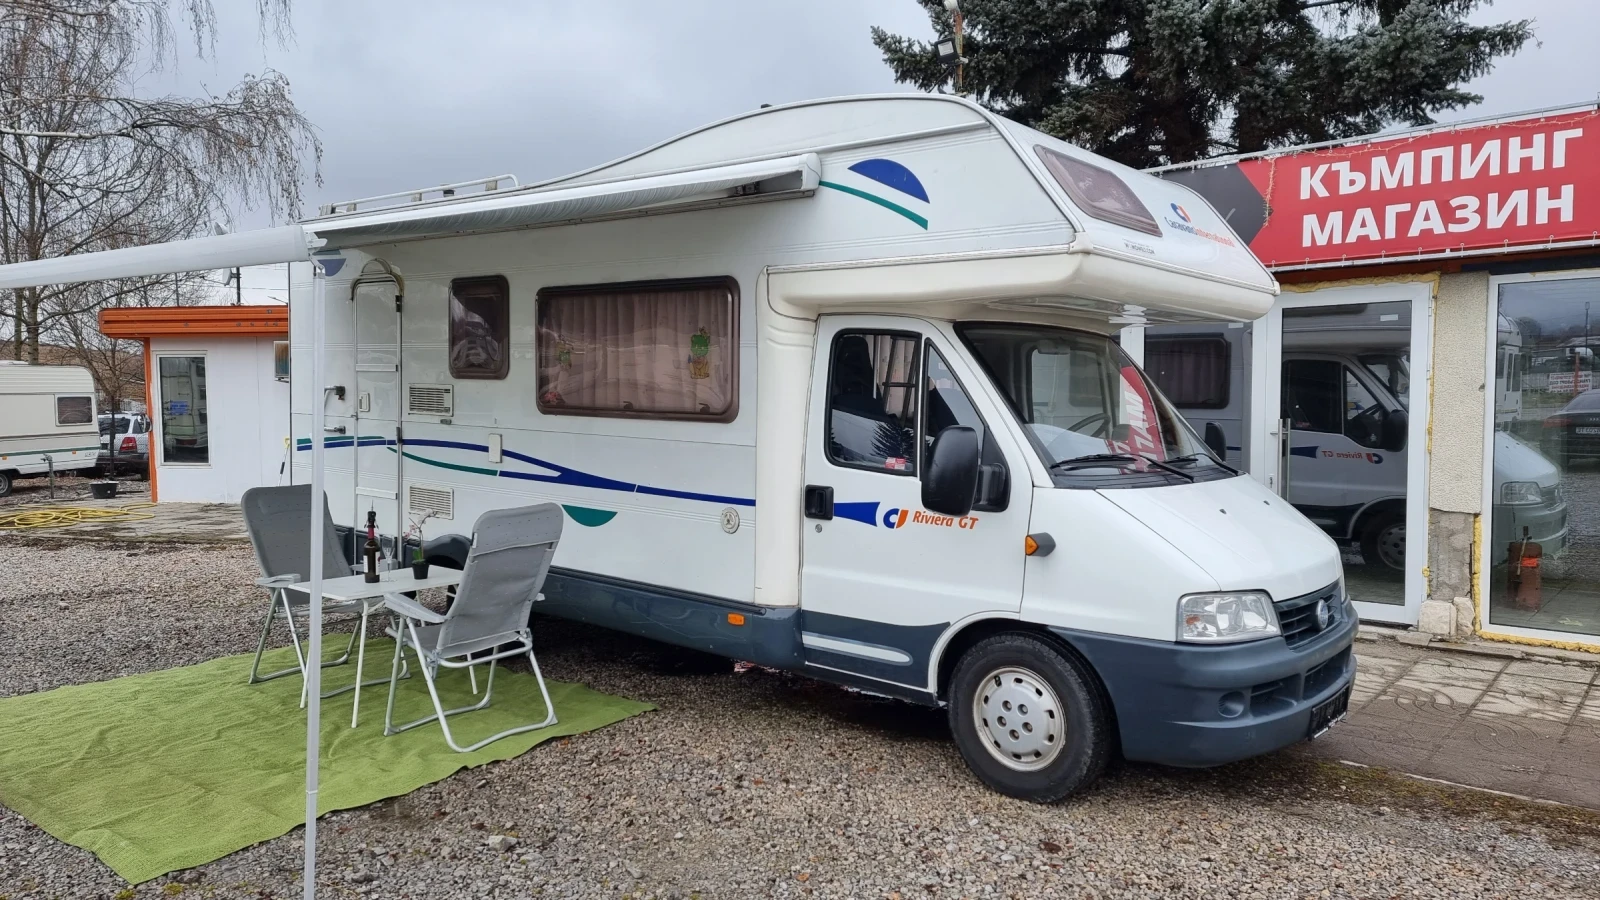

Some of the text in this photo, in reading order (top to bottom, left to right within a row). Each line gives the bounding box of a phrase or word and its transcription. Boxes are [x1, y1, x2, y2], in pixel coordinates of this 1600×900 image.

[1300, 128, 1583, 199] КЪМПИНГ
[1302, 184, 1574, 247] МАГАЗИН
[912, 510, 954, 528] Riviera
[958, 515, 979, 530] GT
